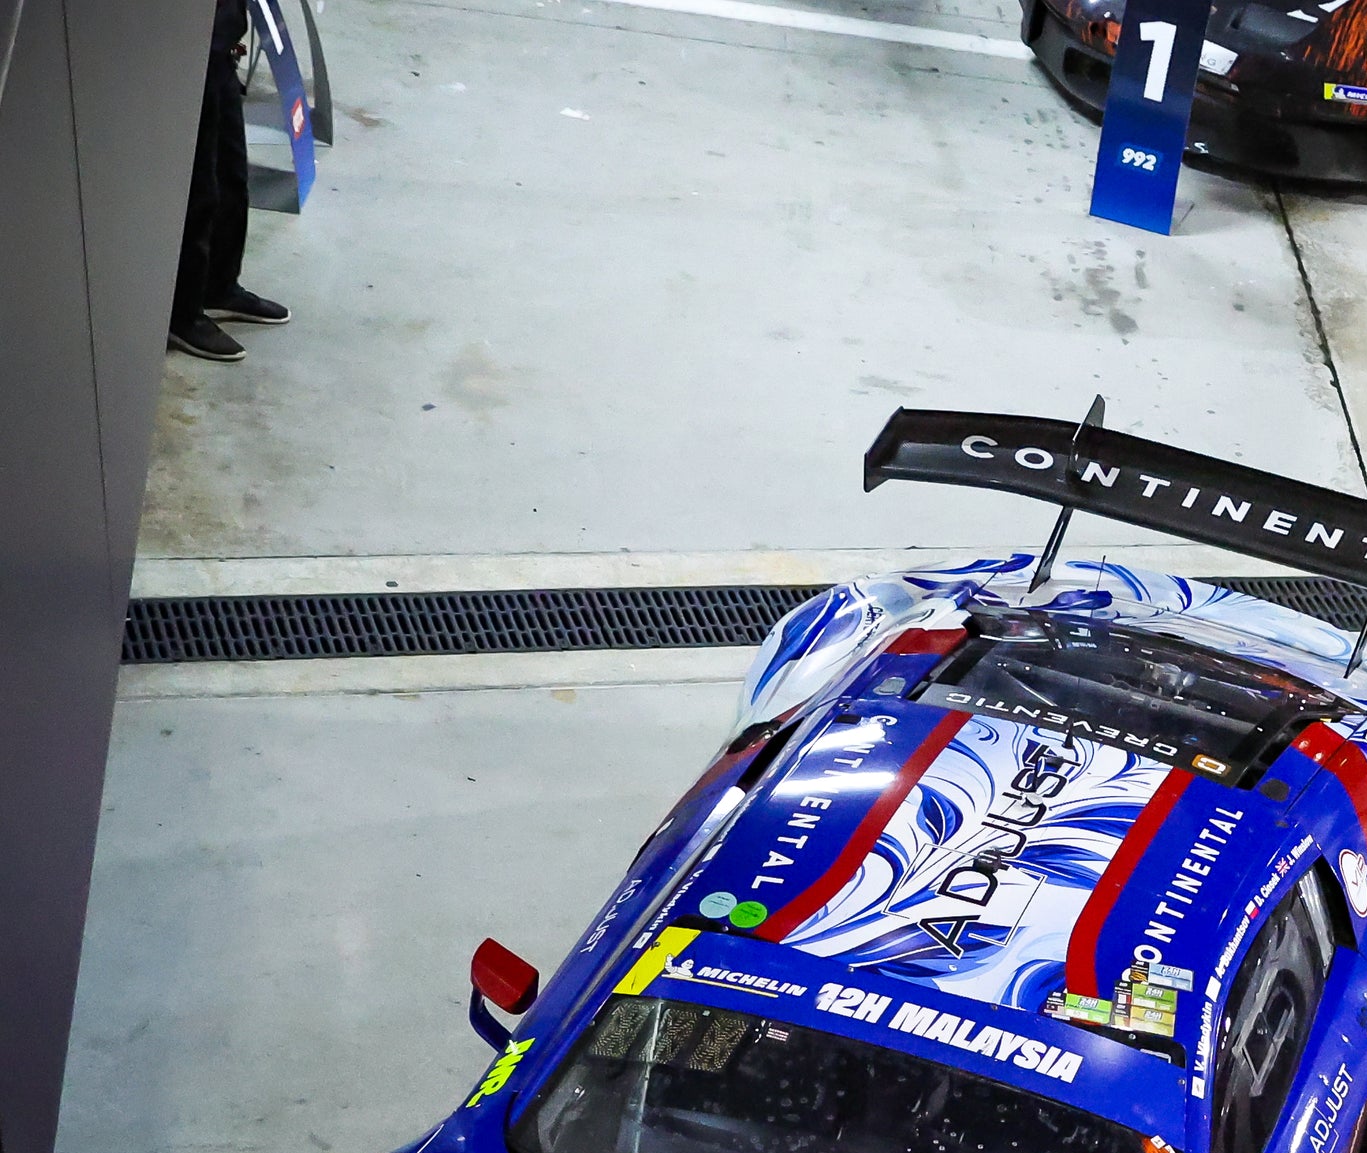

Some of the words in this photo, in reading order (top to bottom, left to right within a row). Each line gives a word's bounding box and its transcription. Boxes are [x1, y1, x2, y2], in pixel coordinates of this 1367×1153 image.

[1139, 20, 1178, 103] 1
[1120, 147, 1157, 172] 992
[946, 692, 1178, 757] CREVENTIC
[696, 966, 809, 997] MICHELIN
[814, 981, 893, 1024] 12H
[888, 1000, 1085, 1086] MALAYSIA
